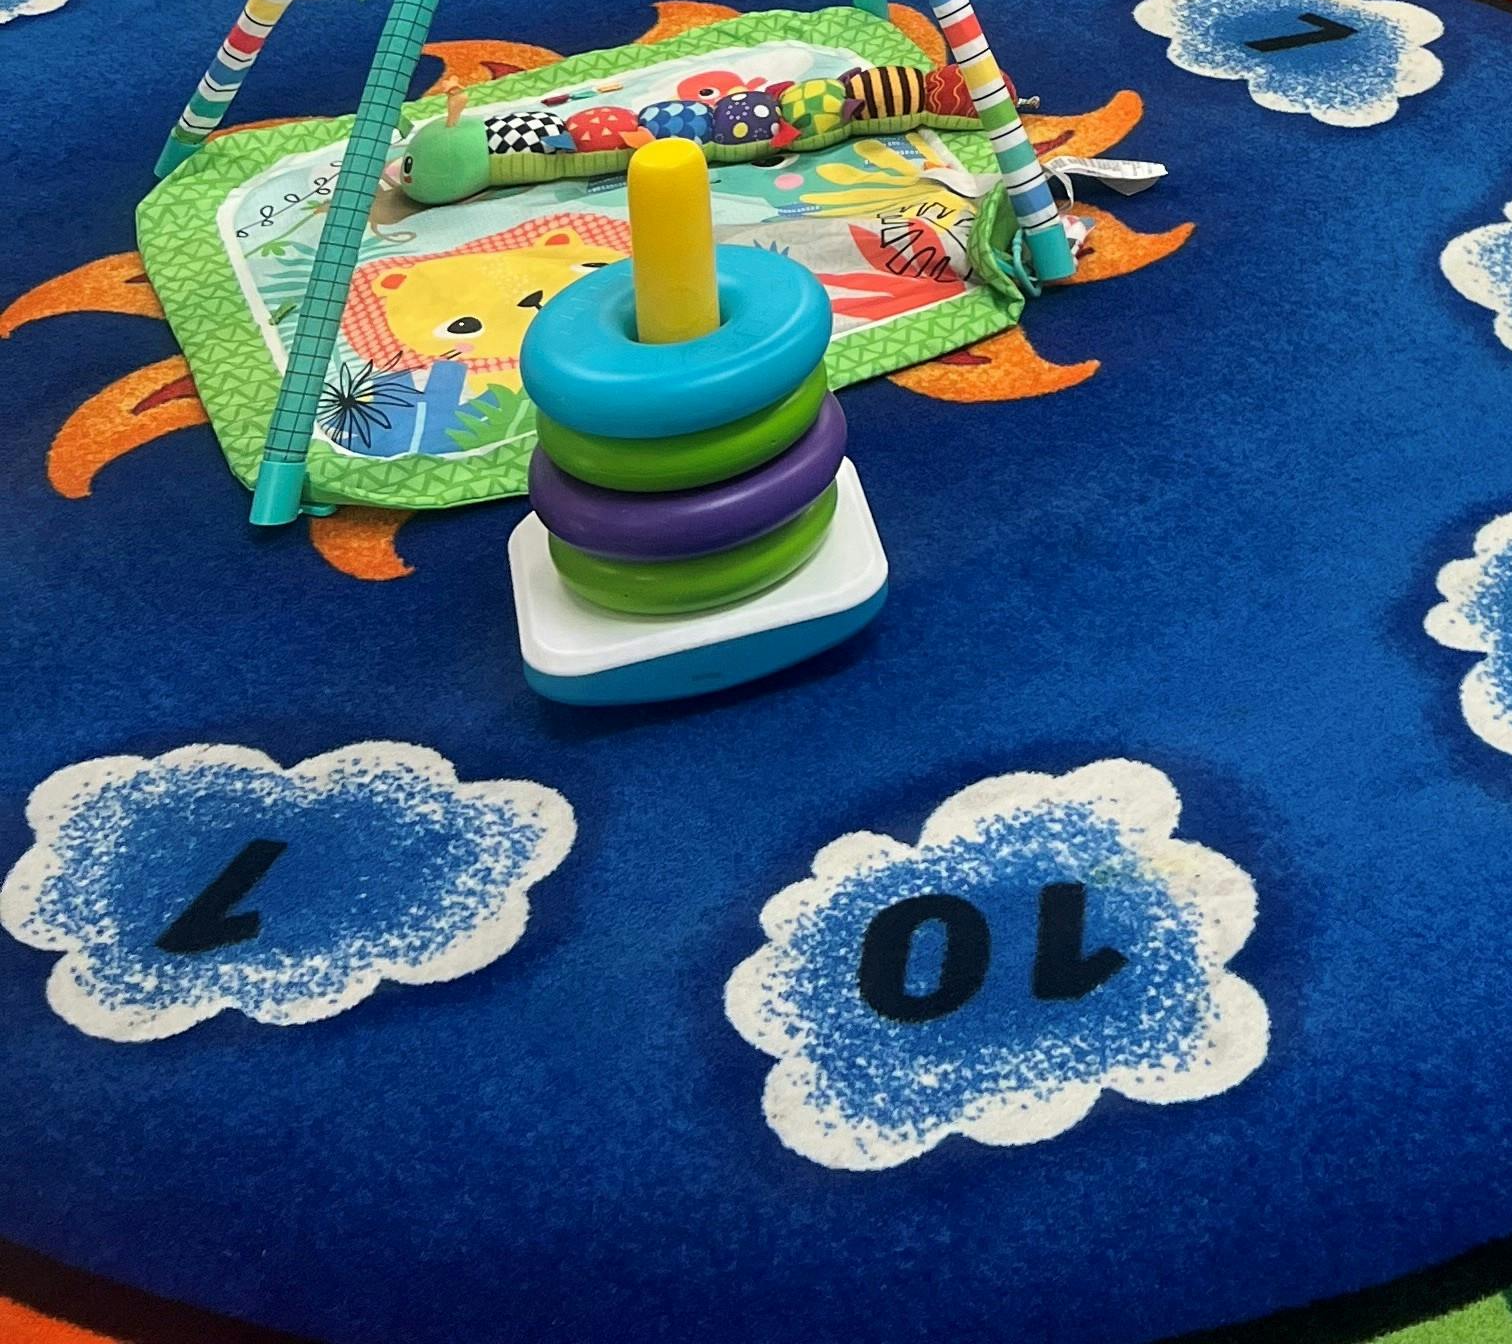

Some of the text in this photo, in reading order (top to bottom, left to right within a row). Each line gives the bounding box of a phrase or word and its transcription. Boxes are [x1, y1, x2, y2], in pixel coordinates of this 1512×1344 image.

[1245, 13, 1357, 52] 7
[151, 837, 288, 954] 1
[857, 882, 1129, 1024] 10
